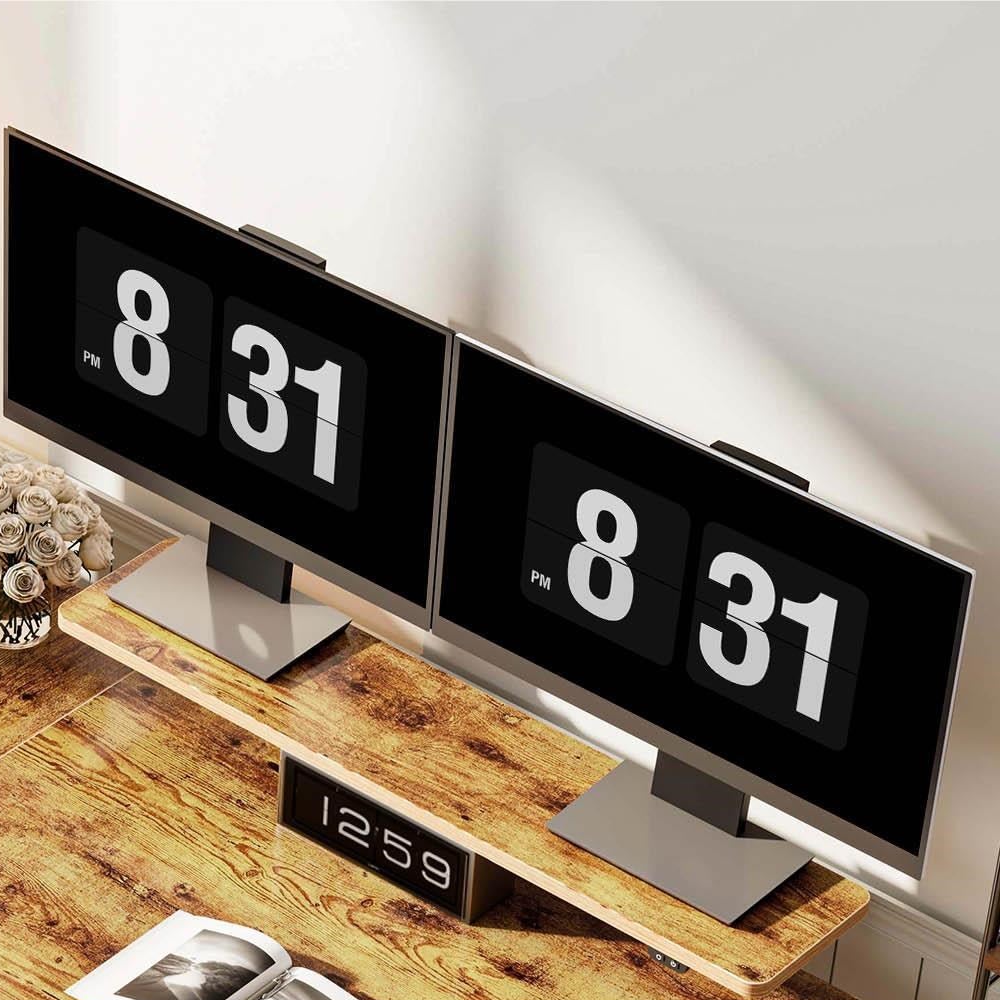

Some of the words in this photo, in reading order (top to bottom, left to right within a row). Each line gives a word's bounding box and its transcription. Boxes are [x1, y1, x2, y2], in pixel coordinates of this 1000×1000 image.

[83, 349, 101, 370] PM
[113, 268, 171, 397] 8
[227, 323, 343, 485] 31
[530, 569, 551, 591] PM
[567, 488, 638, 622] 8
[699, 551, 839, 723] 31
